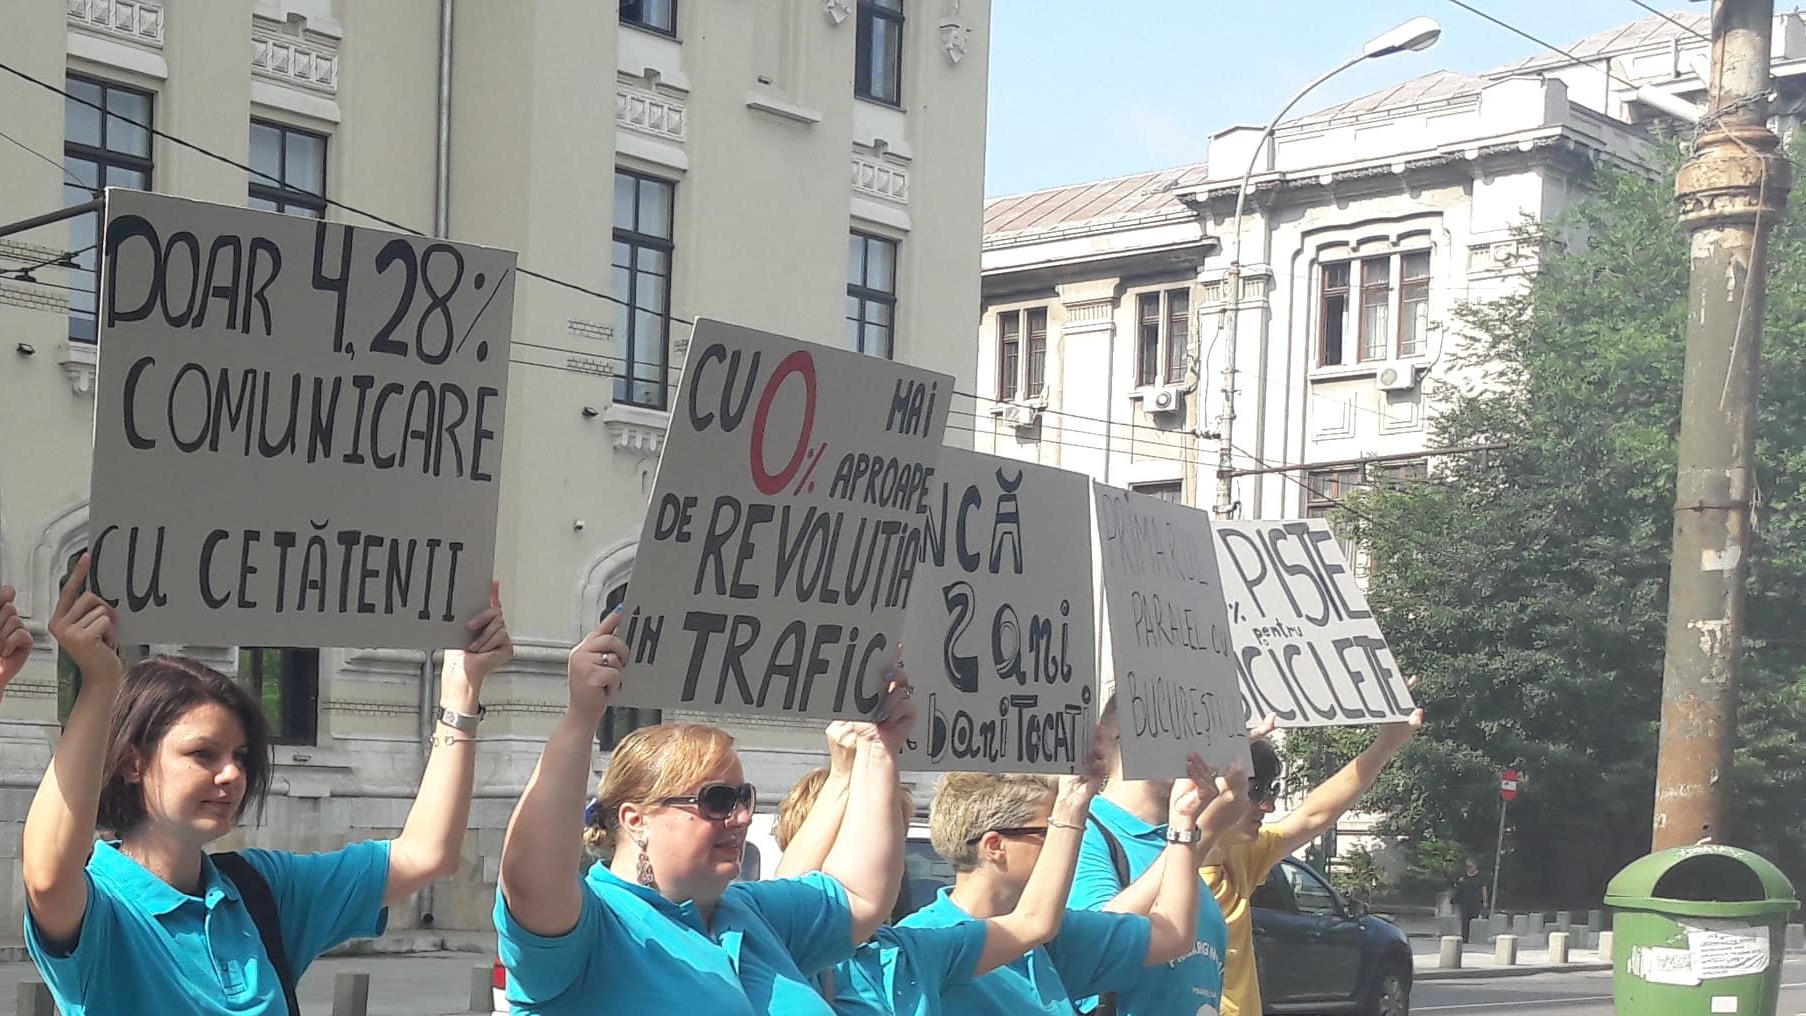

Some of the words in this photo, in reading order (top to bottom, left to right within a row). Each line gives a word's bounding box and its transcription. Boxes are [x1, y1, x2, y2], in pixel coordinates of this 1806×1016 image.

[105, 214, 282, 336] DOAR
[122, 355, 499, 482] COMUNICARE
[688, 343, 761, 433] CU
[653, 492, 699, 544] DE
[828, 452, 936, 515] APROAPE
[918, 466, 1025, 575] NCĂ
[89, 524, 168, 613] CU
[1217, 521, 1374, 628] PISTE
[1252, 617, 1304, 646] pentru
[926, 692, 1011, 764] bani
